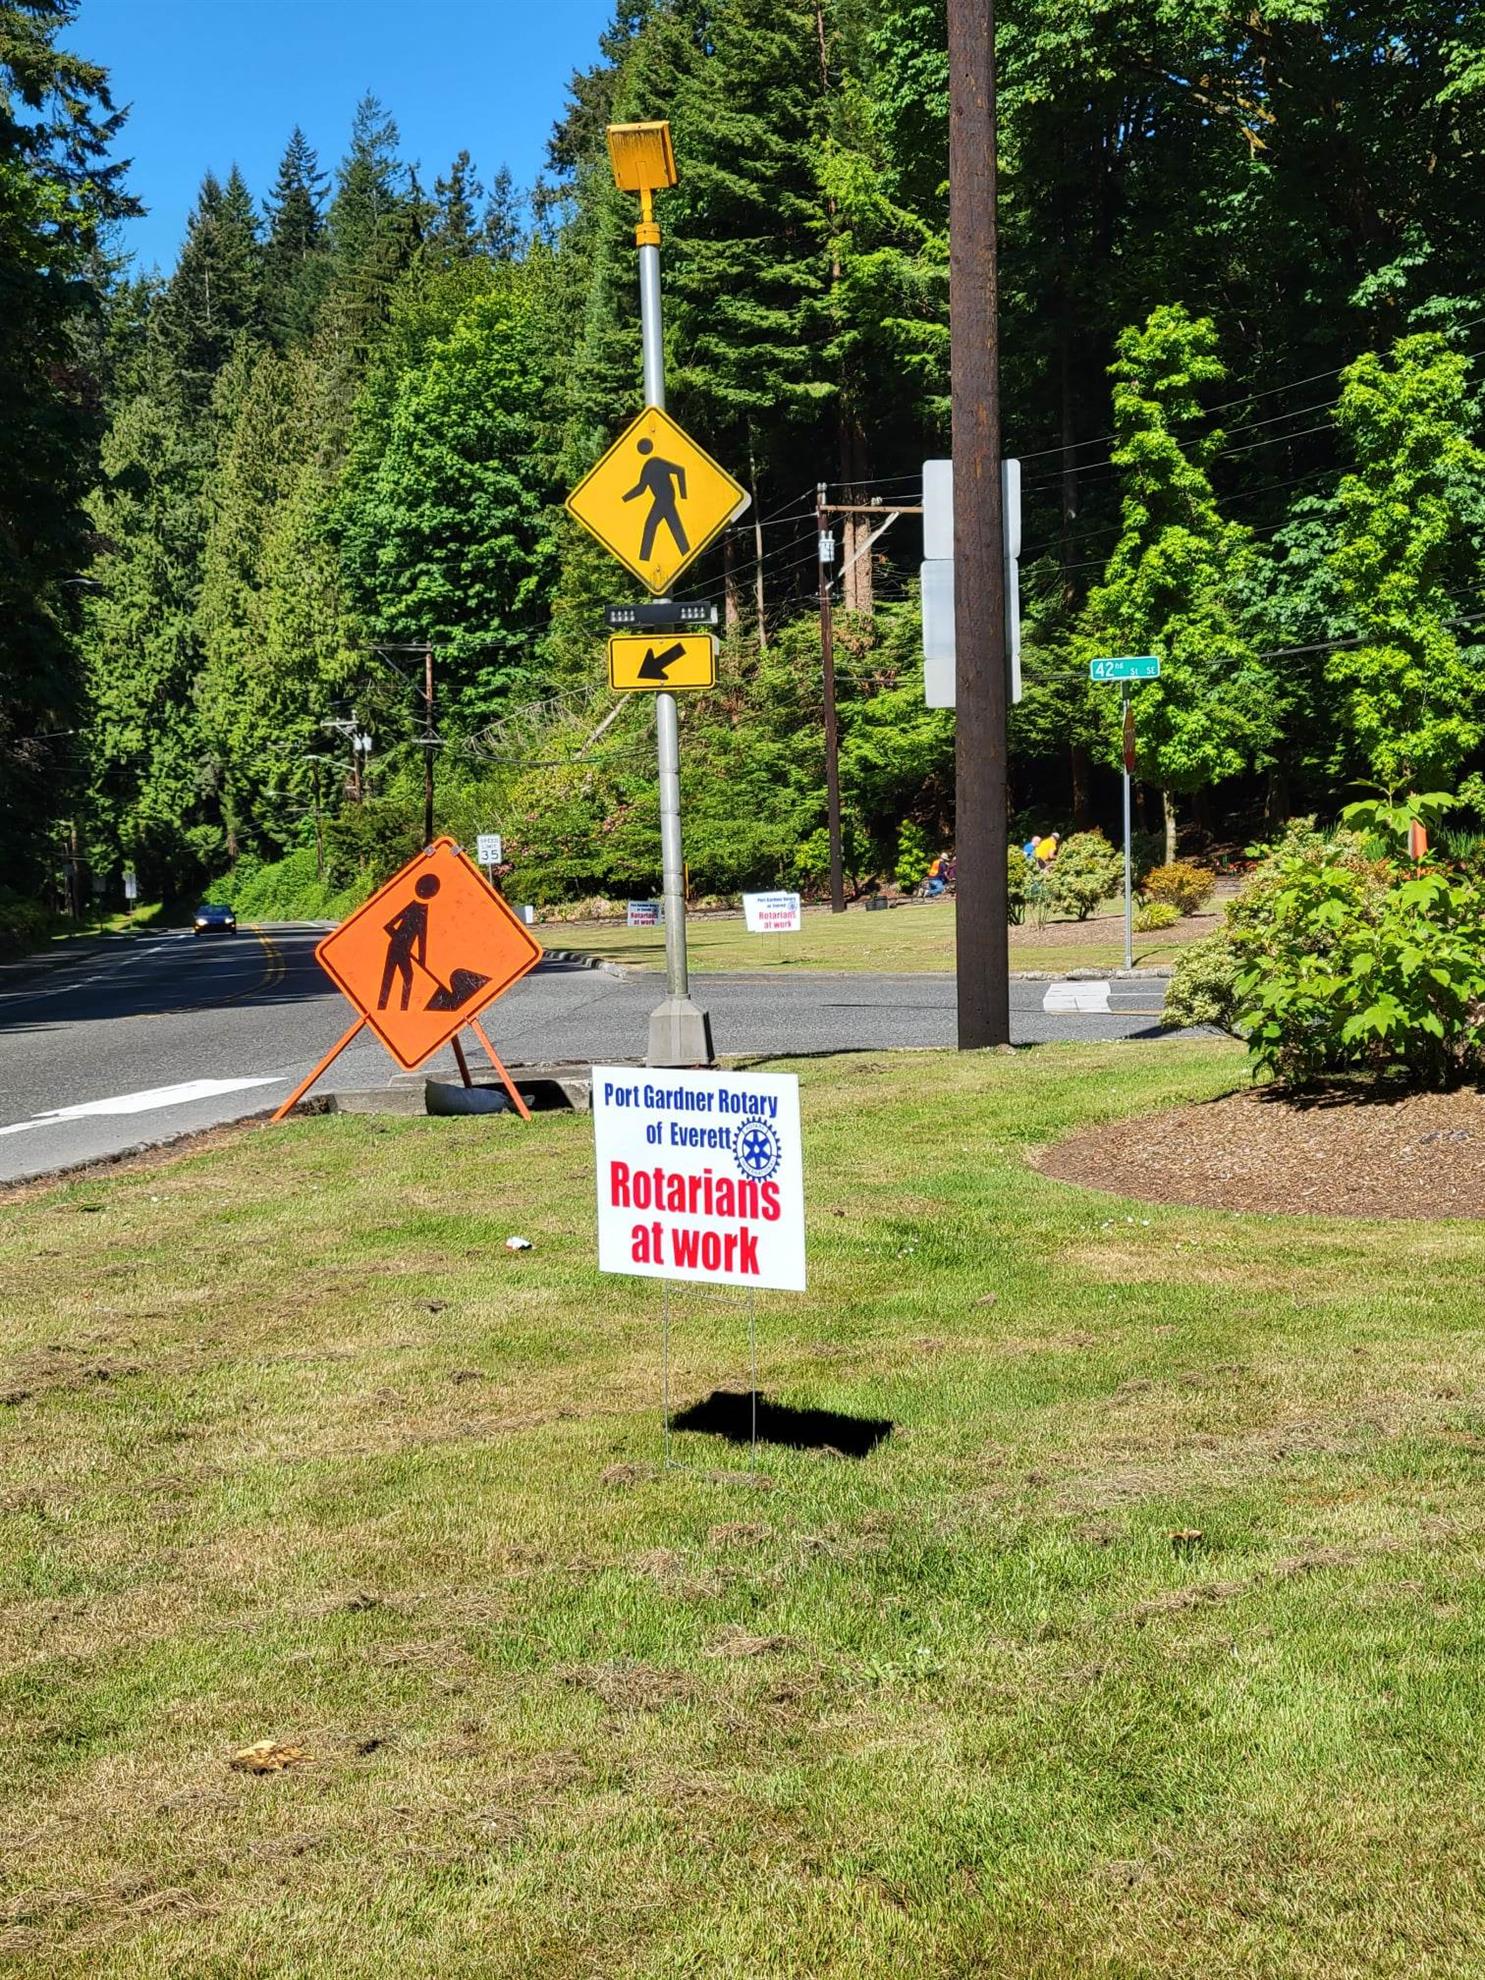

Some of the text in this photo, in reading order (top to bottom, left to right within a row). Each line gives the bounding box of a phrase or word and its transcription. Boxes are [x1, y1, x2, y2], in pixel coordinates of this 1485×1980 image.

[1130, 667, 1138, 675] St
[1146, 666, 1156, 675] SE
[481, 850, 498, 860] 35
[604, 1082, 778, 1118] Port Gardner Rotary
[646, 1121, 732, 1149] of Everett
[610, 1160, 781, 1221] Rotarians
[631, 1221, 760, 1275] at work
